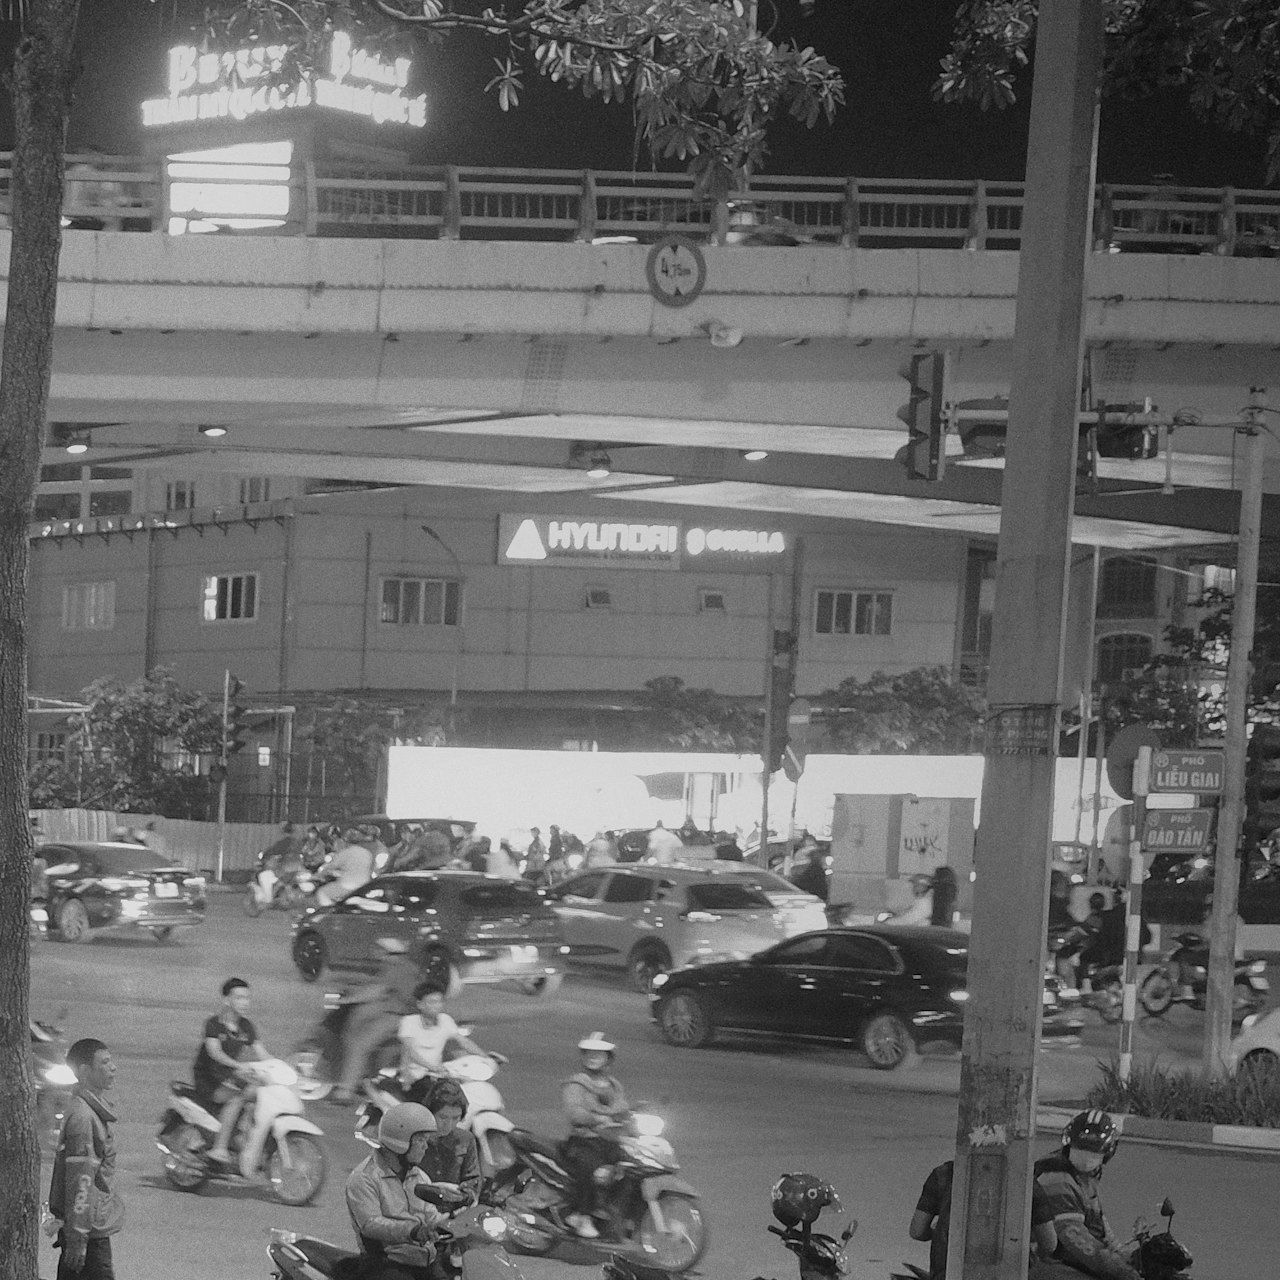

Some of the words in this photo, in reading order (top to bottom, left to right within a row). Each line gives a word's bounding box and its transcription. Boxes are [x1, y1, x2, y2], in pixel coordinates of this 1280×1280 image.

[548, 521, 678, 552] HYUNDAI
[1157, 765, 1188, 787] LIỄU
[1191, 772, 1219, 788] GIAI
[74, 1174, 92, 1214] Grab
